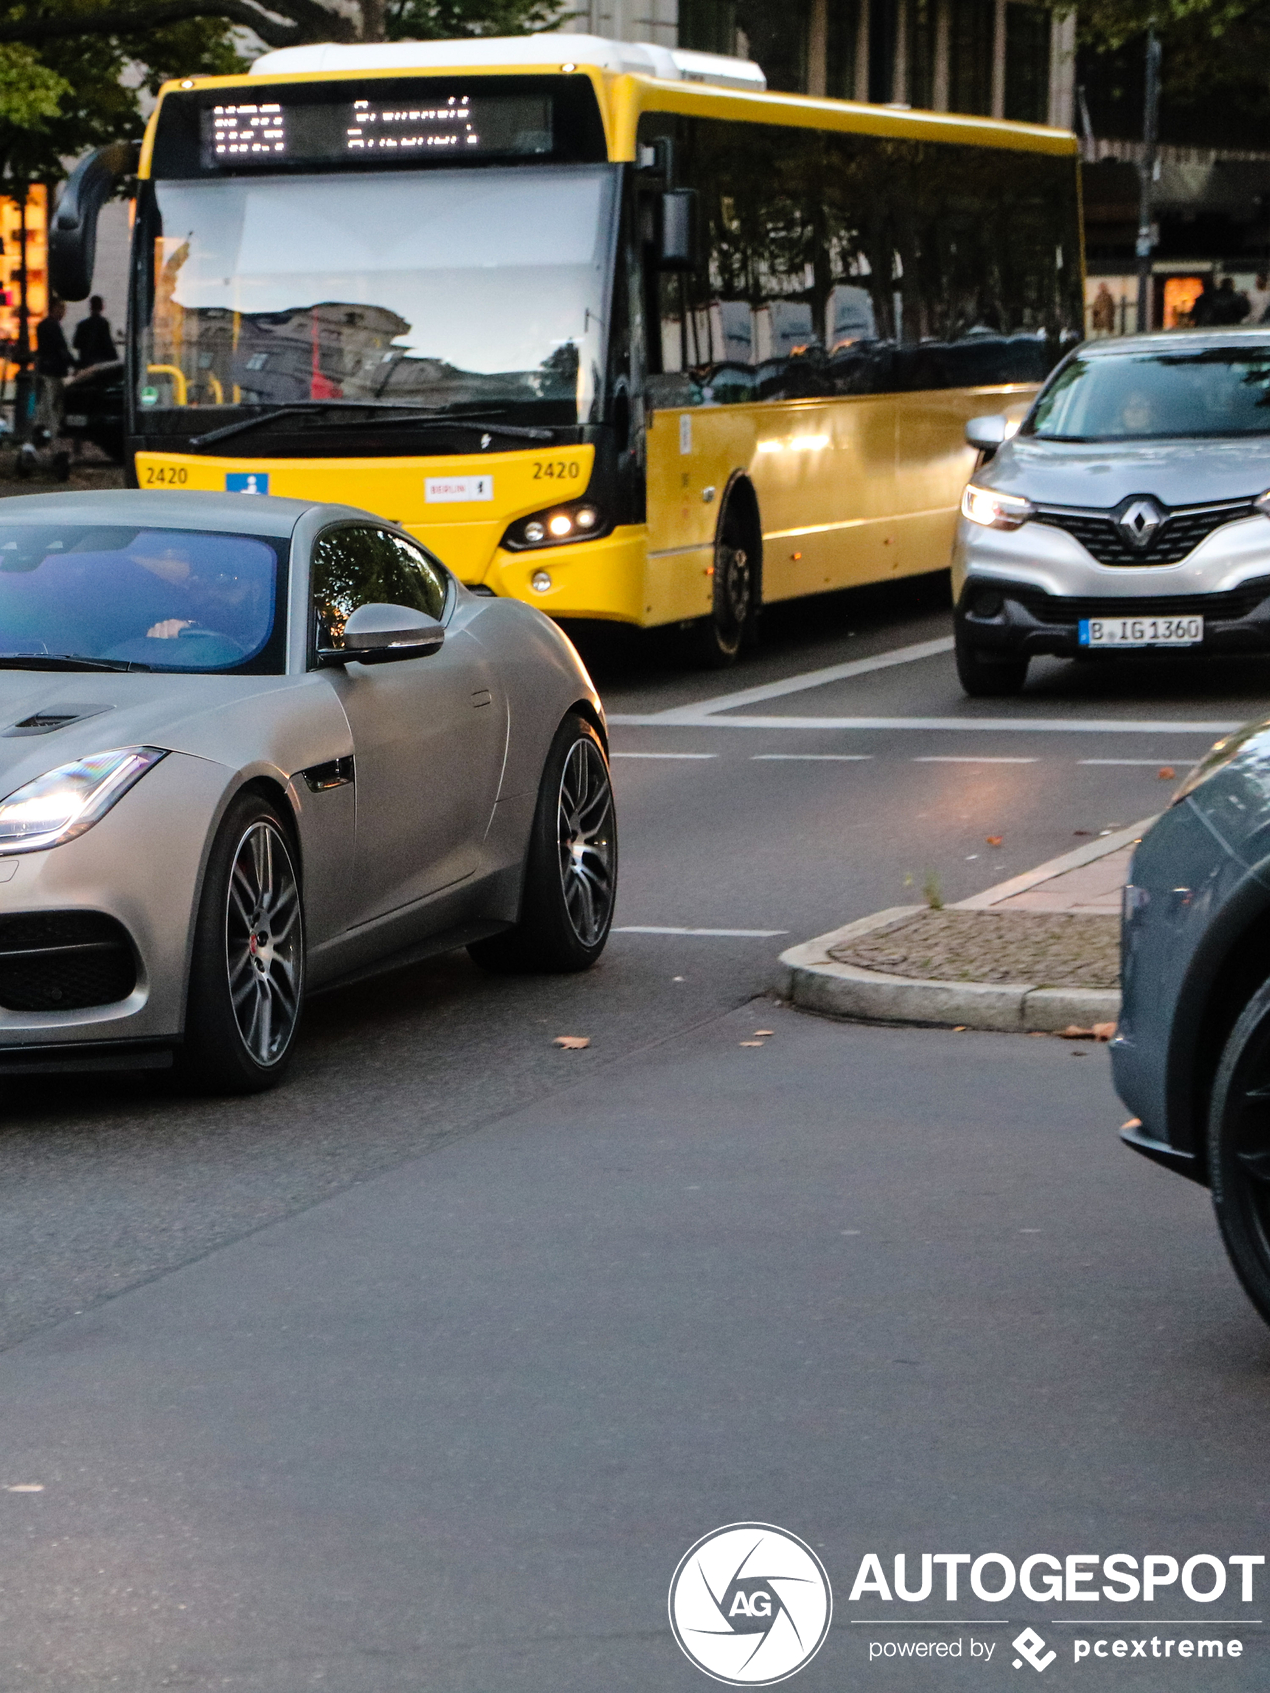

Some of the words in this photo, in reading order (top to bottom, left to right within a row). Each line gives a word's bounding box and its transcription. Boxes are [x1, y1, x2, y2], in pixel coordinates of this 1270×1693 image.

[146, 467, 189, 484] 2420
[533, 462, 580, 479] 2420
[430, 485, 466, 495] BERLIN
[1091, 622, 1104, 640] B
